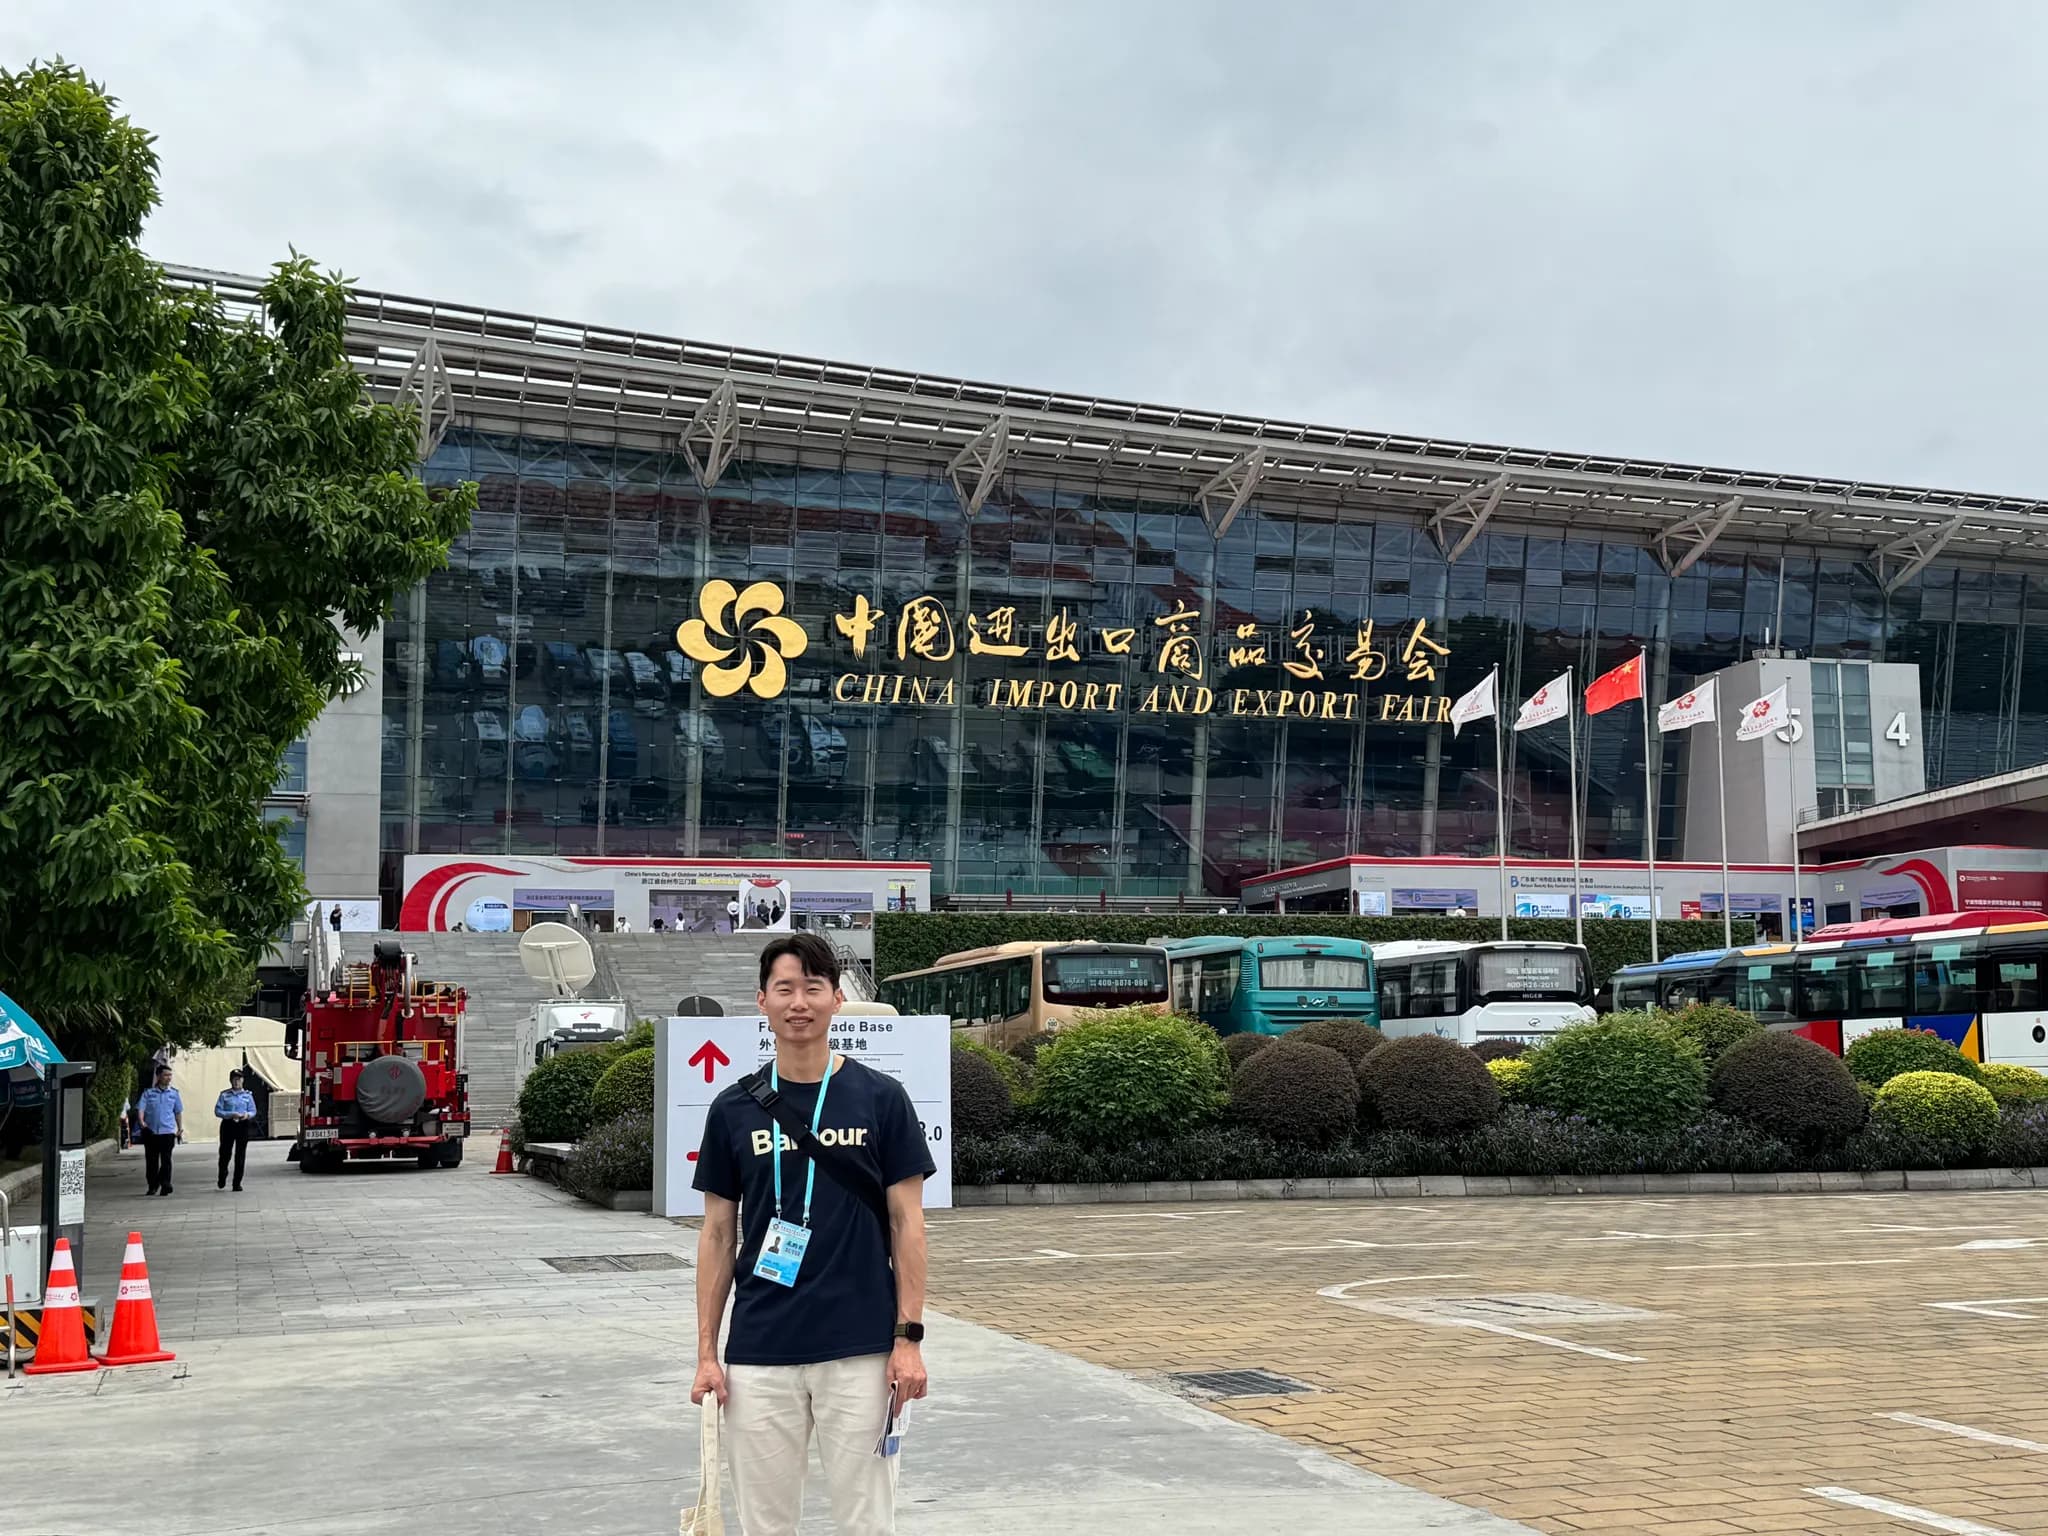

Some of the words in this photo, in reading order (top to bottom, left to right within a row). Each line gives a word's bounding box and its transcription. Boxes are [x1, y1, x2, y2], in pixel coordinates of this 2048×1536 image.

[835, 673, 954, 705] CHINA
[988, 679, 1122, 711] IMPORT
[1139, 685, 1213, 714] AND
[1233, 688, 1358, 719] EXPORT
[1380, 693, 1451, 723] FAIR
[1885, 711, 1910, 747] 4
[859, 1021, 893, 1032] Base
[751, 1128, 867, 1155] Baour
